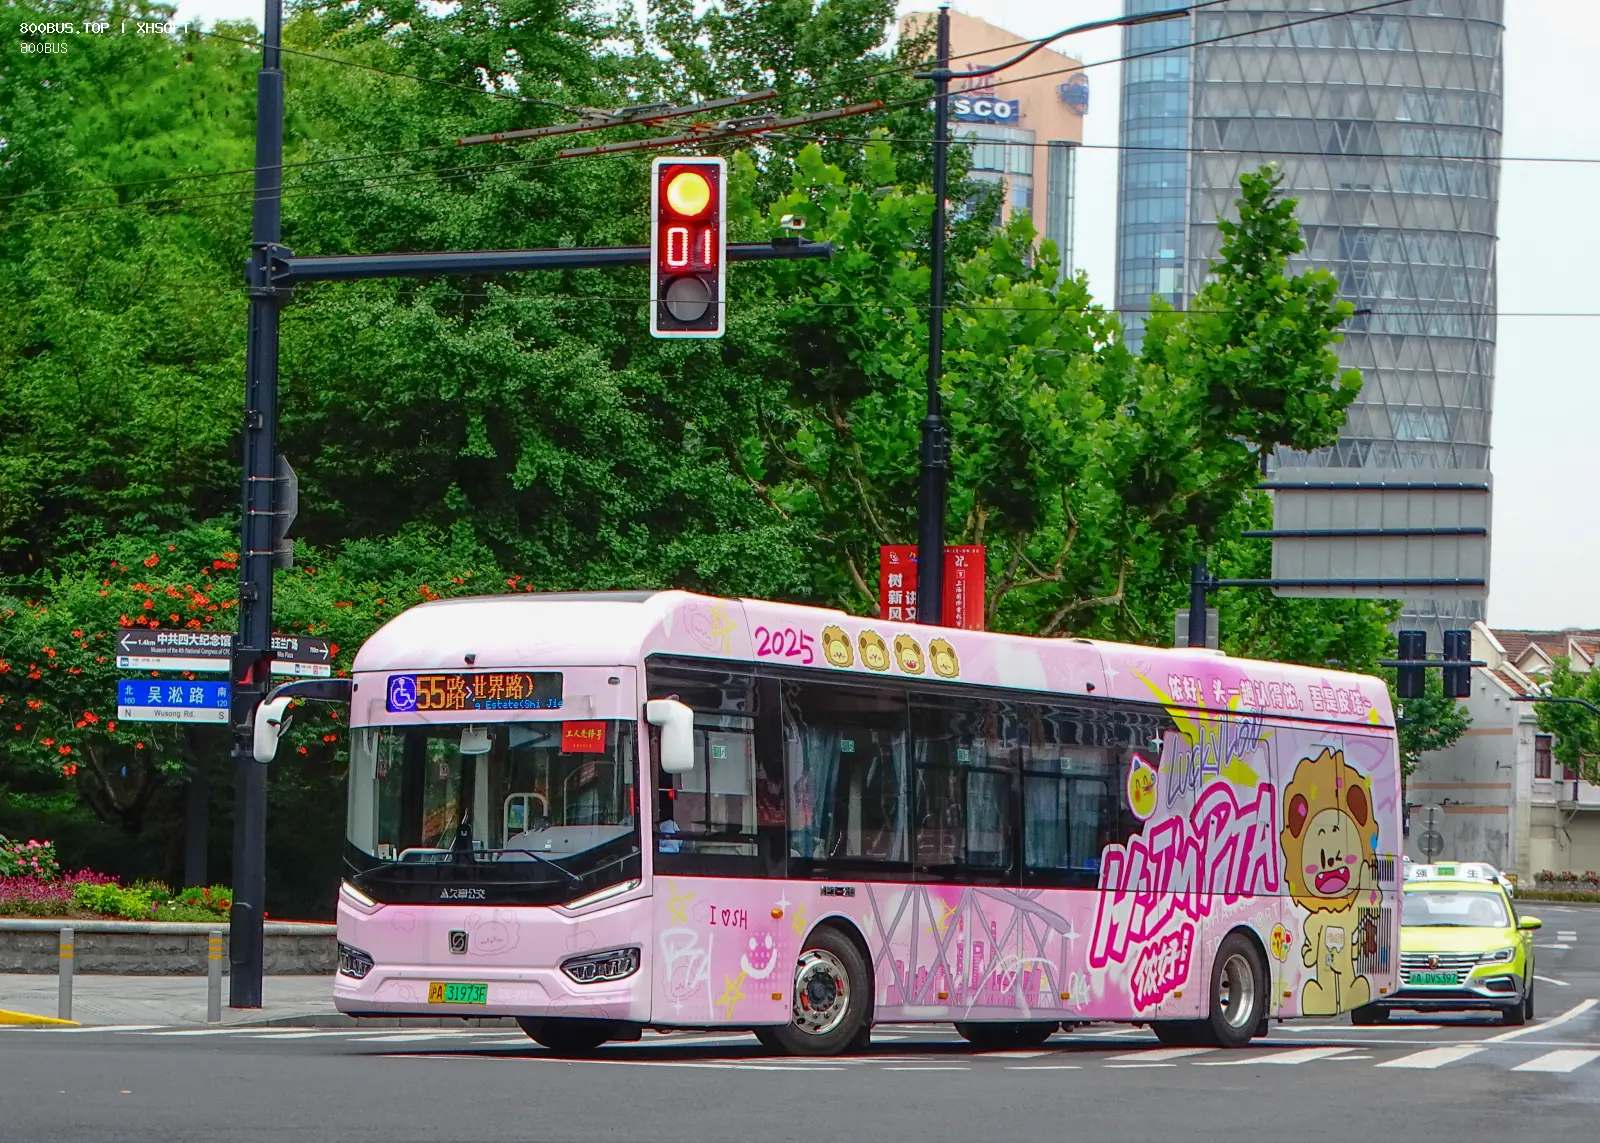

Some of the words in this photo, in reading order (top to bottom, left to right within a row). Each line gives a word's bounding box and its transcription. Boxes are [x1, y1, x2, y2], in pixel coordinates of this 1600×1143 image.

[929, 99, 1011, 119] SCO
[667, 227, 711, 266] 01
[888, 573, 902, 620] 树新风
[157, 632, 232, 647] 中共四大纪念馆
[754, 626, 815, 665] 2025
[124, 685, 134, 695] 北
[147, 686, 204, 704] 吴淞路
[217, 687, 227, 697] 南
[217, 699, 227, 707] 120
[125, 709, 131, 717] N
[154, 710, 180, 718] Wusong
[183, 710, 195, 718] Rd.
[219, 712, 225, 720] S
[565, 728, 603, 741] 工人先锋号
[1466, 868, 1479, 878] 生
